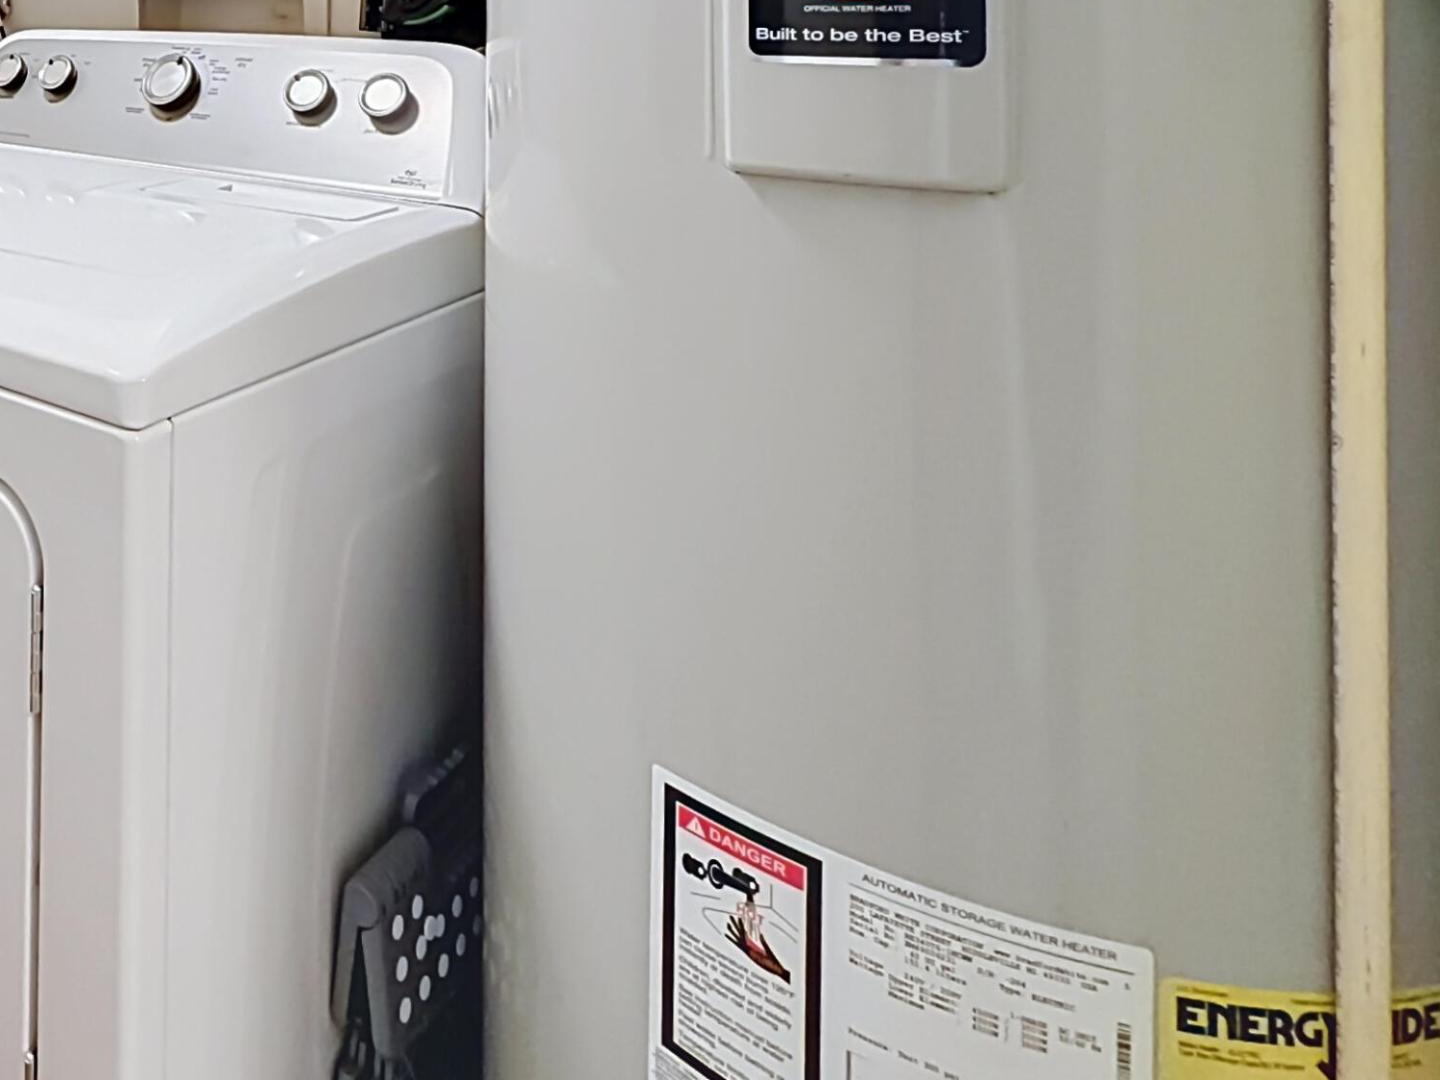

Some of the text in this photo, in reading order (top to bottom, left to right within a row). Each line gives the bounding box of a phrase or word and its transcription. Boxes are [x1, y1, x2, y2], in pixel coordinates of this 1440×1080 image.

[803, 5, 912, 13] OFFICIAL WATER HEATER
[755, 27, 964, 44] Built to be the Best
[708, 826, 788, 878] DANGER
[861, 874, 938, 909] AUTOMATIC
[940, 902, 1008, 932] STORAGE
[1010, 925, 1059, 947] WATER
[1062, 939, 1118, 962] HEATER
